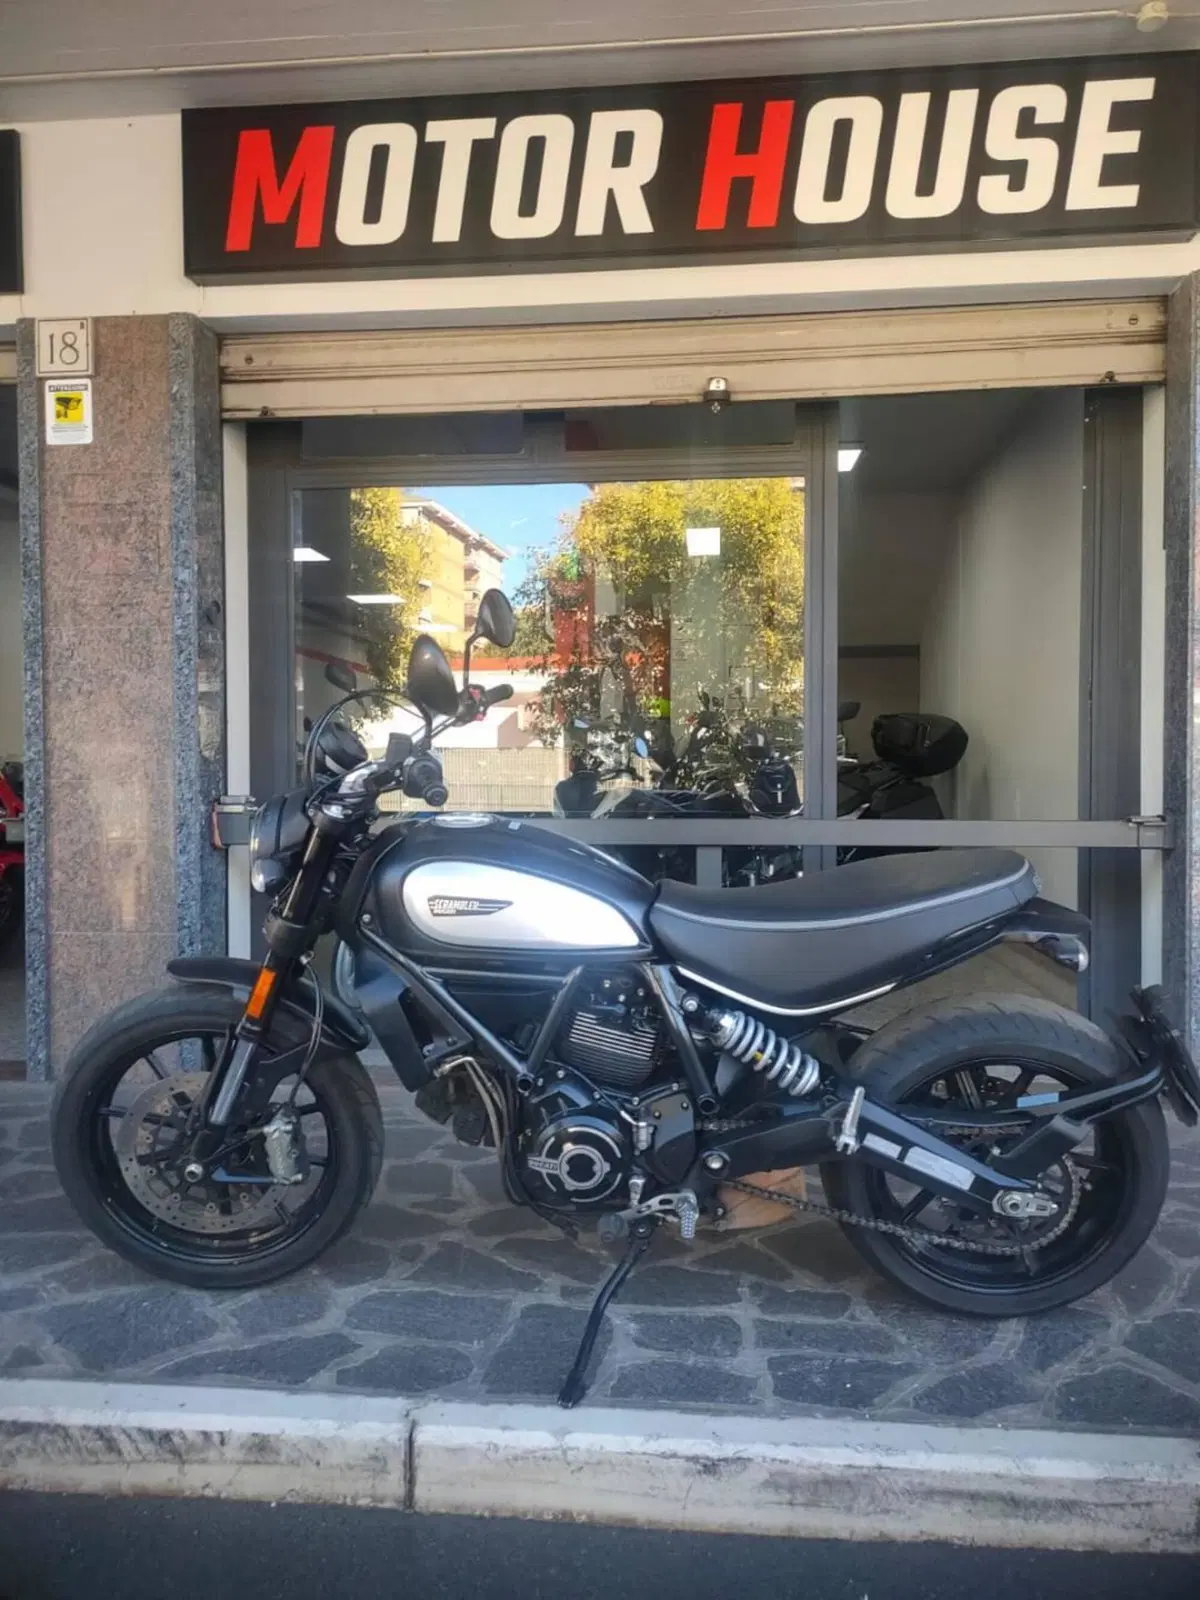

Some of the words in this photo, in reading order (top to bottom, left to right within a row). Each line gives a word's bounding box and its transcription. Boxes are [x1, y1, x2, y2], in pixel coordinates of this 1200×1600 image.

[225, 109, 663, 252] MOTOR
[695, 77, 1155, 230] HOUSE
[434, 899, 479, 910] SCRAMBLER
